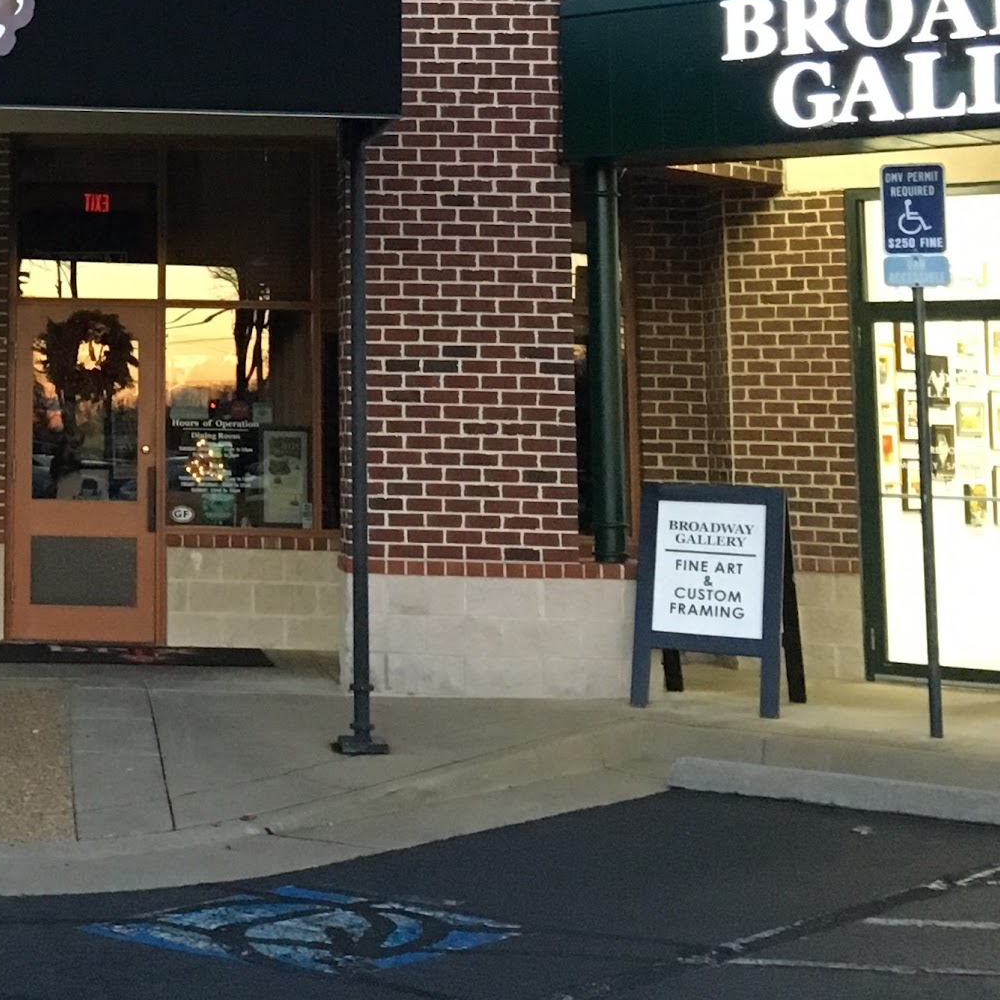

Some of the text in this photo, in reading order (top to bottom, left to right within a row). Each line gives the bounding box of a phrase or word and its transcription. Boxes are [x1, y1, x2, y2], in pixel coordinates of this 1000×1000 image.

[884, 170, 939, 184] DMV PERMIT
[890, 185, 935, 198] REQUIRED
[887, 236, 944, 249] $250 FINE
[171, 419, 260, 430] Hours of Operation
[190, 431, 241, 441] Dining Room
[668, 519, 755, 536] BROADWAY
[674, 532, 747, 548] GALLERY
[675, 558, 744, 575] FINE ART
[703, 575, 713, 587] &
[674, 586, 742, 603] CUSTOM
[669, 602, 745, 620] FRAMING
